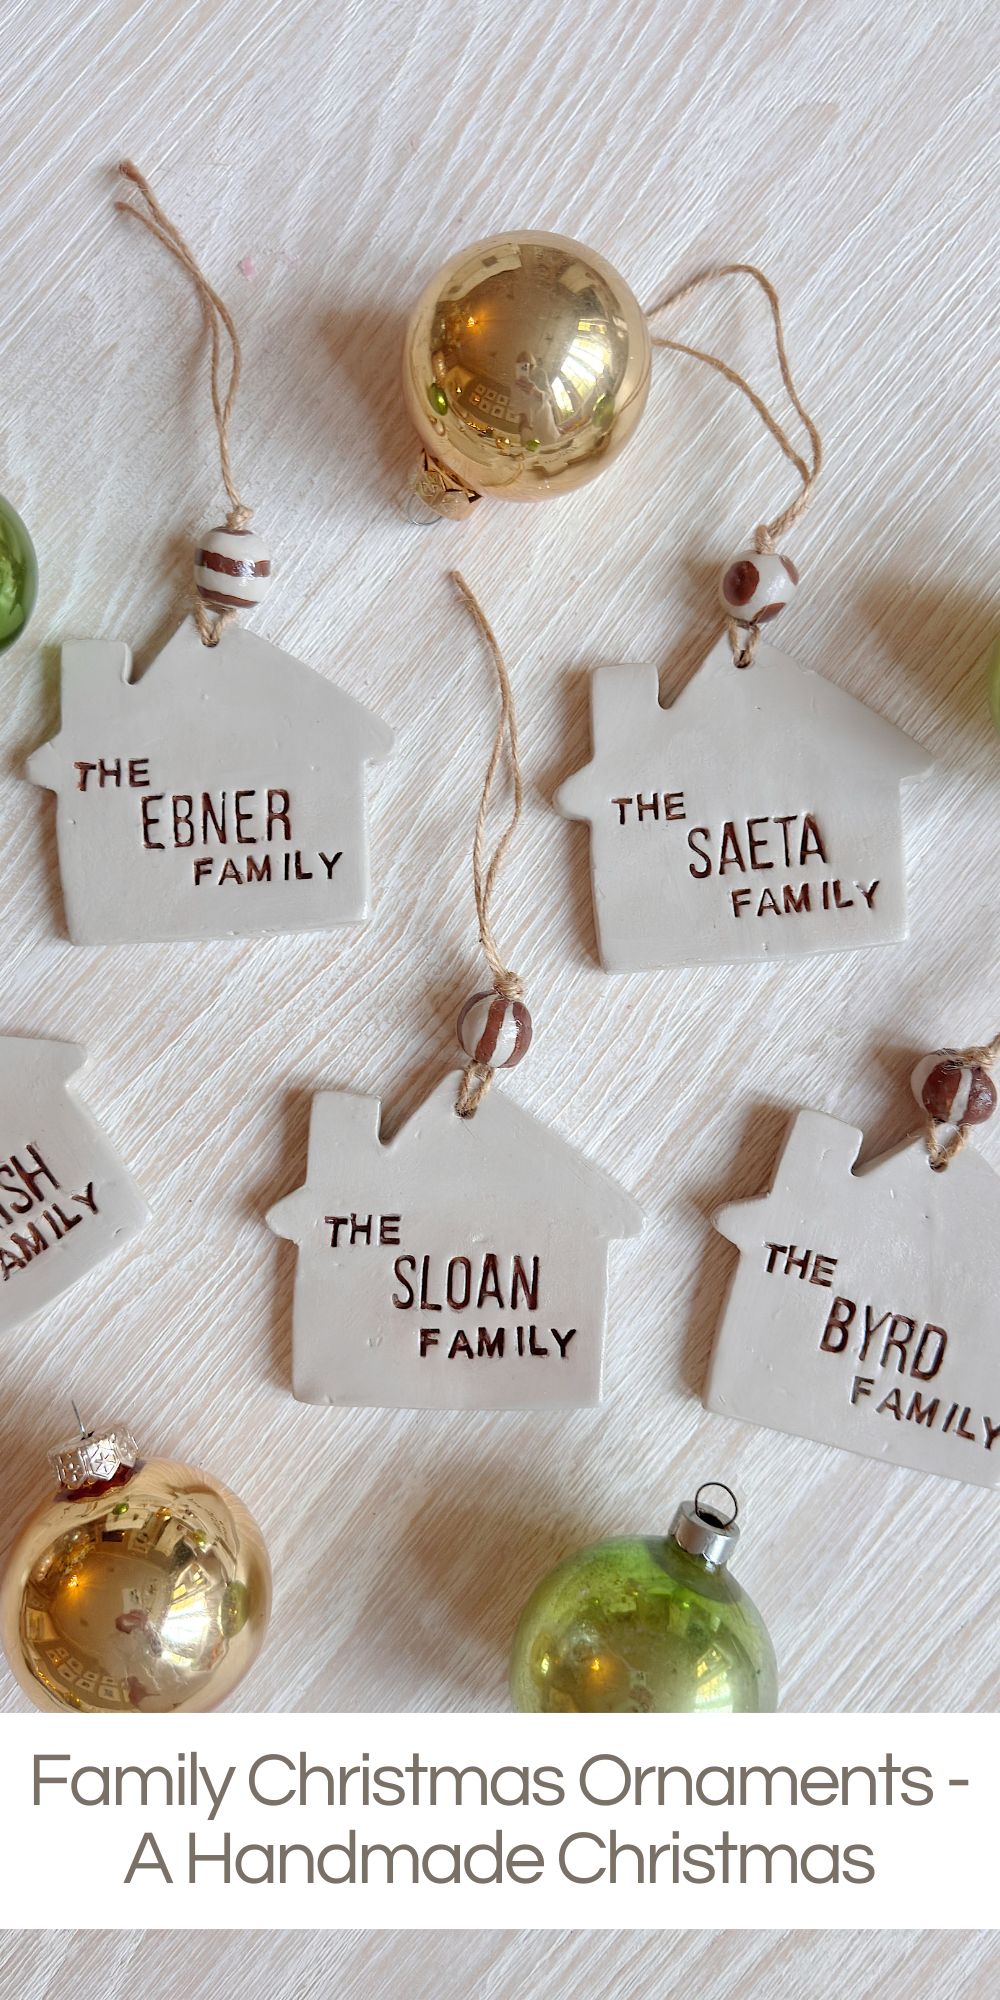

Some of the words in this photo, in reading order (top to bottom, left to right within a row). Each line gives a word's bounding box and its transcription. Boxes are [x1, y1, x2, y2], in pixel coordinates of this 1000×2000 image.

[74, 758, 150, 792] THE
[141, 789, 292, 850] EBNER
[611, 791, 686, 825] THE
[688, 814, 826, 879] SAETA
[194, 850, 343, 886] FAMILY
[732, 880, 880, 918] FAMILY
[324, 1214, 401, 1247] THE
[392, 1253, 540, 1310] SLOAN
[764, 1241, 838, 1287] THE
[419, 1325, 577, 1359] FAMILY
[819, 1296, 948, 1381] BYRD
[850, 1376, 1000, 1450] FAMILY
